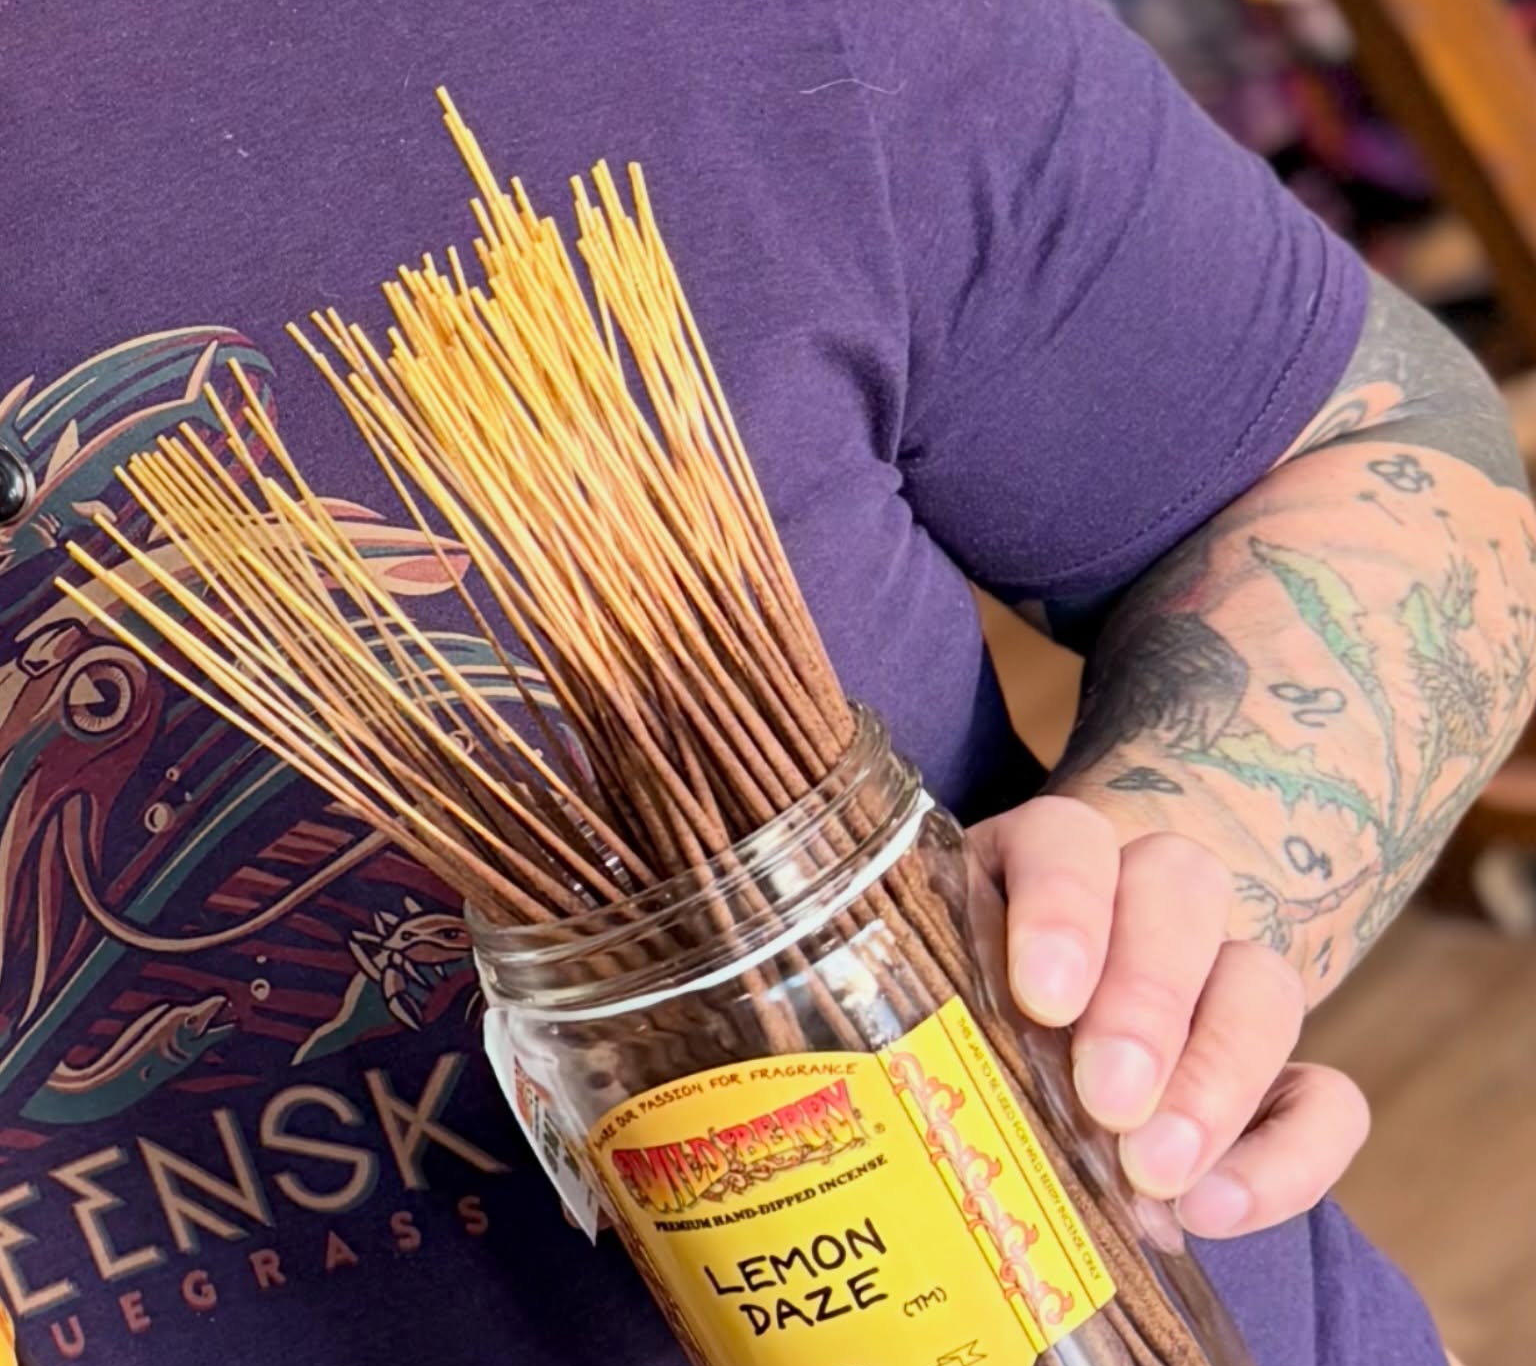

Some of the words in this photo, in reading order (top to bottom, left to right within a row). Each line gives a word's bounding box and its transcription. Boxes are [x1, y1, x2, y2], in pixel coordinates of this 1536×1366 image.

[615, 1109, 640, 1130] OUR
[638, 1082, 705, 1114] PASSION
[709, 1073, 742, 1090] FOR
[750, 1062, 858, 1083] FRAGRANCE
[611, 1137, 729, 1214] WILD
[716, 1077, 861, 1166] BERRY
[654, 1217, 712, 1233] PREMIUM
[712, 1186, 817, 1227] HAND-DIPPED
[817, 1154, 887, 1194] INCENSE
[51, 1195, 490, 1358] UEGRASS
[704, 1217, 886, 1295] LEMON
[739, 1267, 888, 1336] DAZE
[902, 1286, 948, 1317] (TM)
